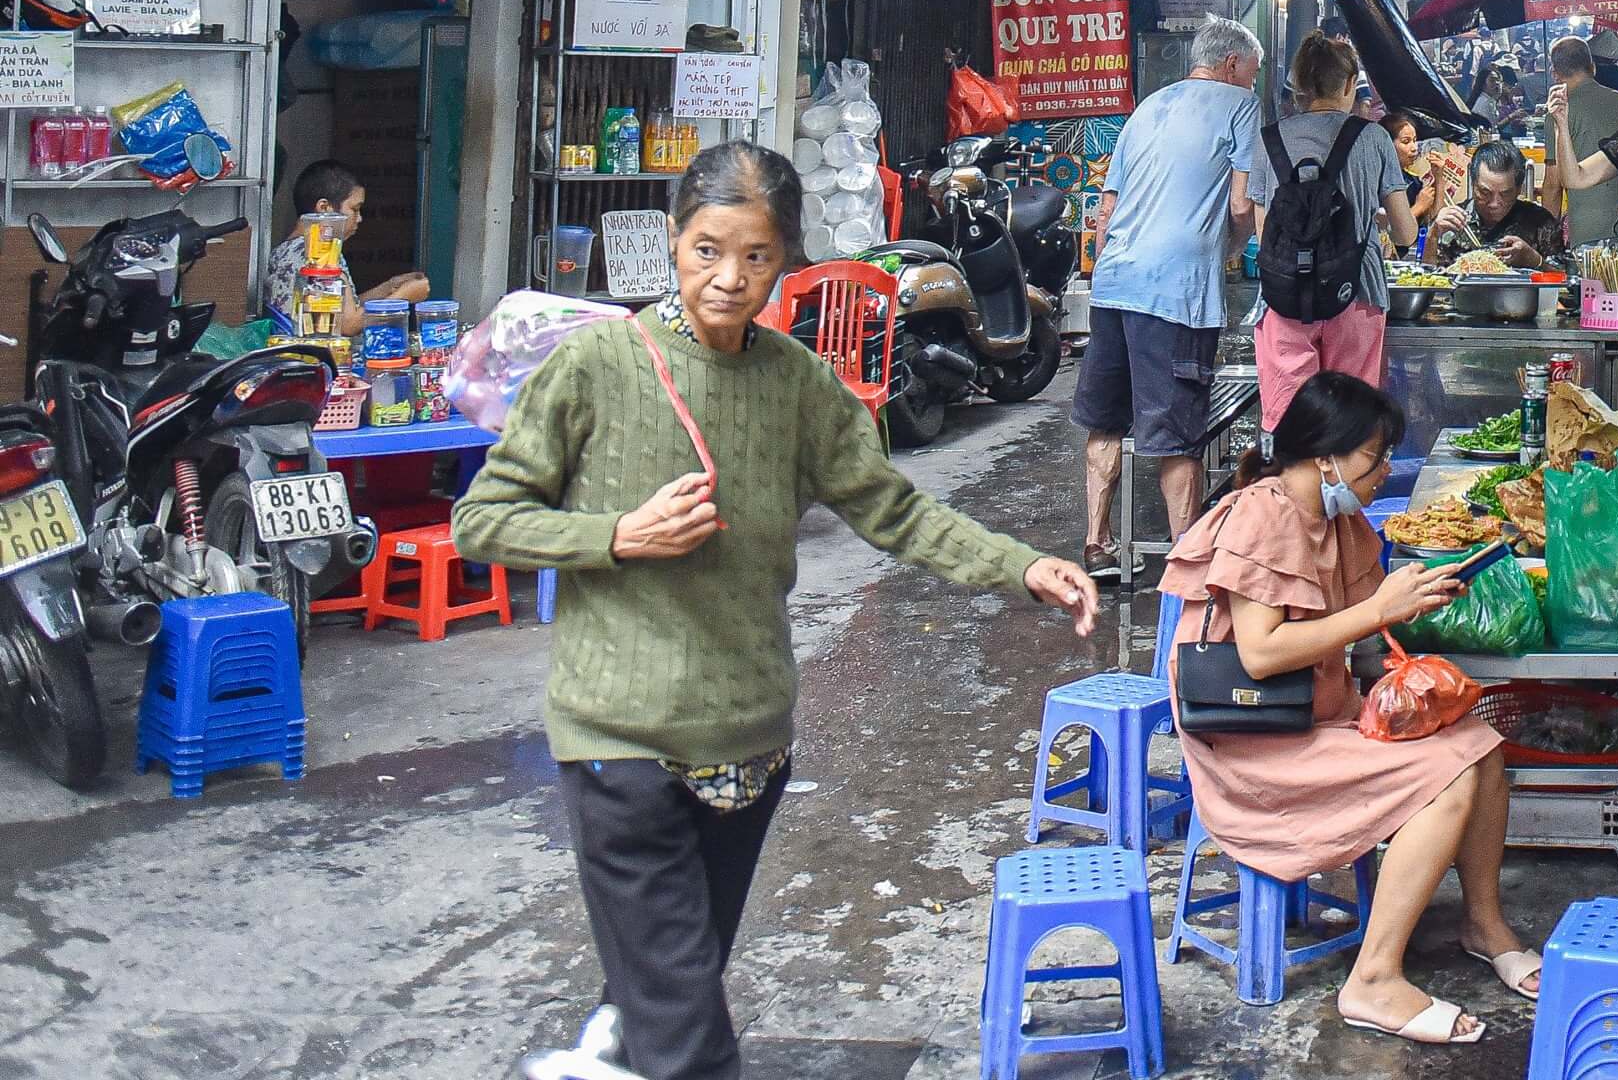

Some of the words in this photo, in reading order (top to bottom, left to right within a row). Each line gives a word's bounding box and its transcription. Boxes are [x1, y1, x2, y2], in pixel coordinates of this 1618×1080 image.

[102, 5, 132, 14] LAVIE
[140, 6, 158, 15] BIA
[998, 16, 1060, 53] QUE
[1067, 11, 1126, 43] TRE
[1038, 52, 1067, 73] CHẢ
[1071, 53, 1090, 71] CÔ
[1094, 54, 1128, 71] NGA)
[12, 80, 31, 88] BIA
[609, 259, 628, 278] BIA
[268, 479, 331, 508] 88-K1
[0, 520, 68, 568] 609
